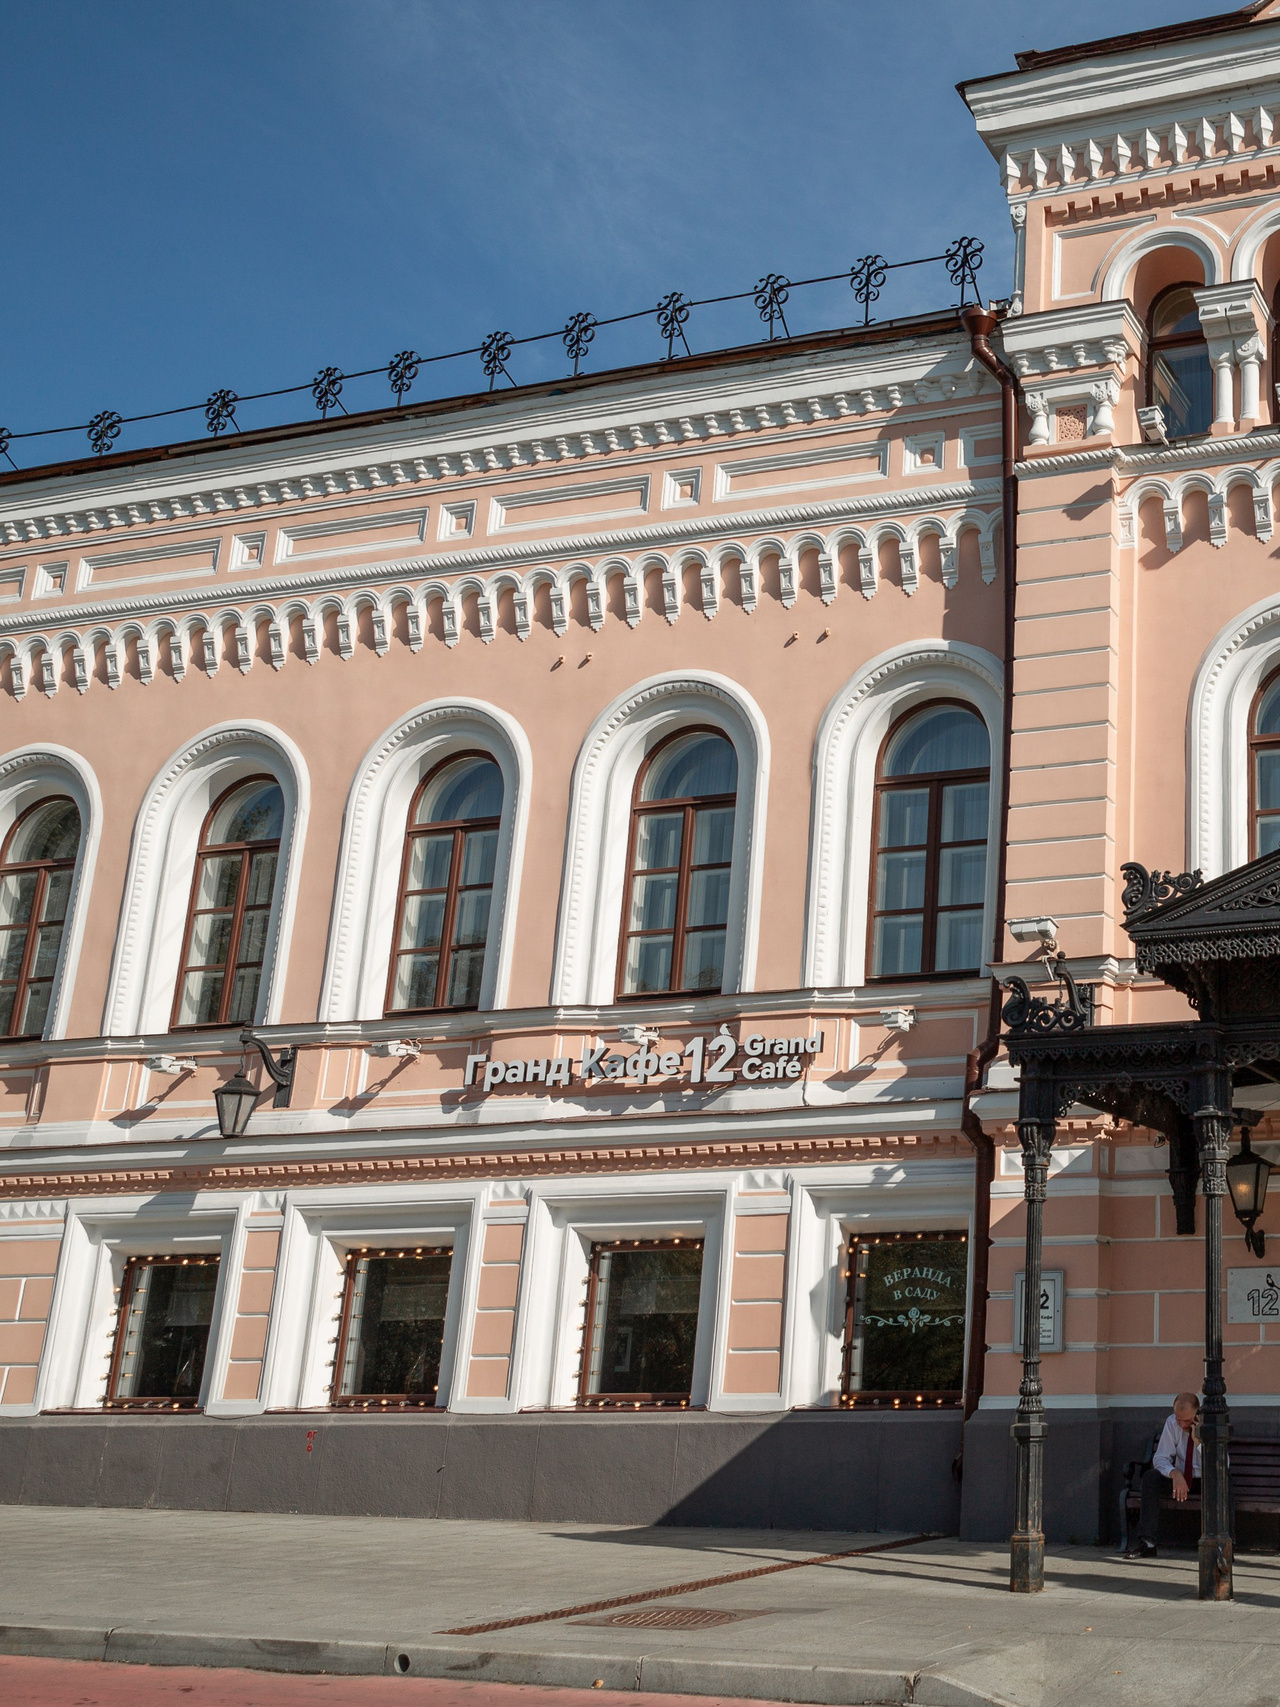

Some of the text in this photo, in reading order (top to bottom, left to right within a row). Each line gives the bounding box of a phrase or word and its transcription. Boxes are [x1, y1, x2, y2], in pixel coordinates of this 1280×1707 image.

[743, 1031, 824, 1055] Grand
[464, 1036, 739, 1092] Гранд Кафе 12
[741, 1055, 802, 1080] Café
[883, 1267, 951, 1288] ВЕРАНДА
[893, 1287, 940, 1300] В САДУ
[1247, 1288, 1279, 1316] 12
